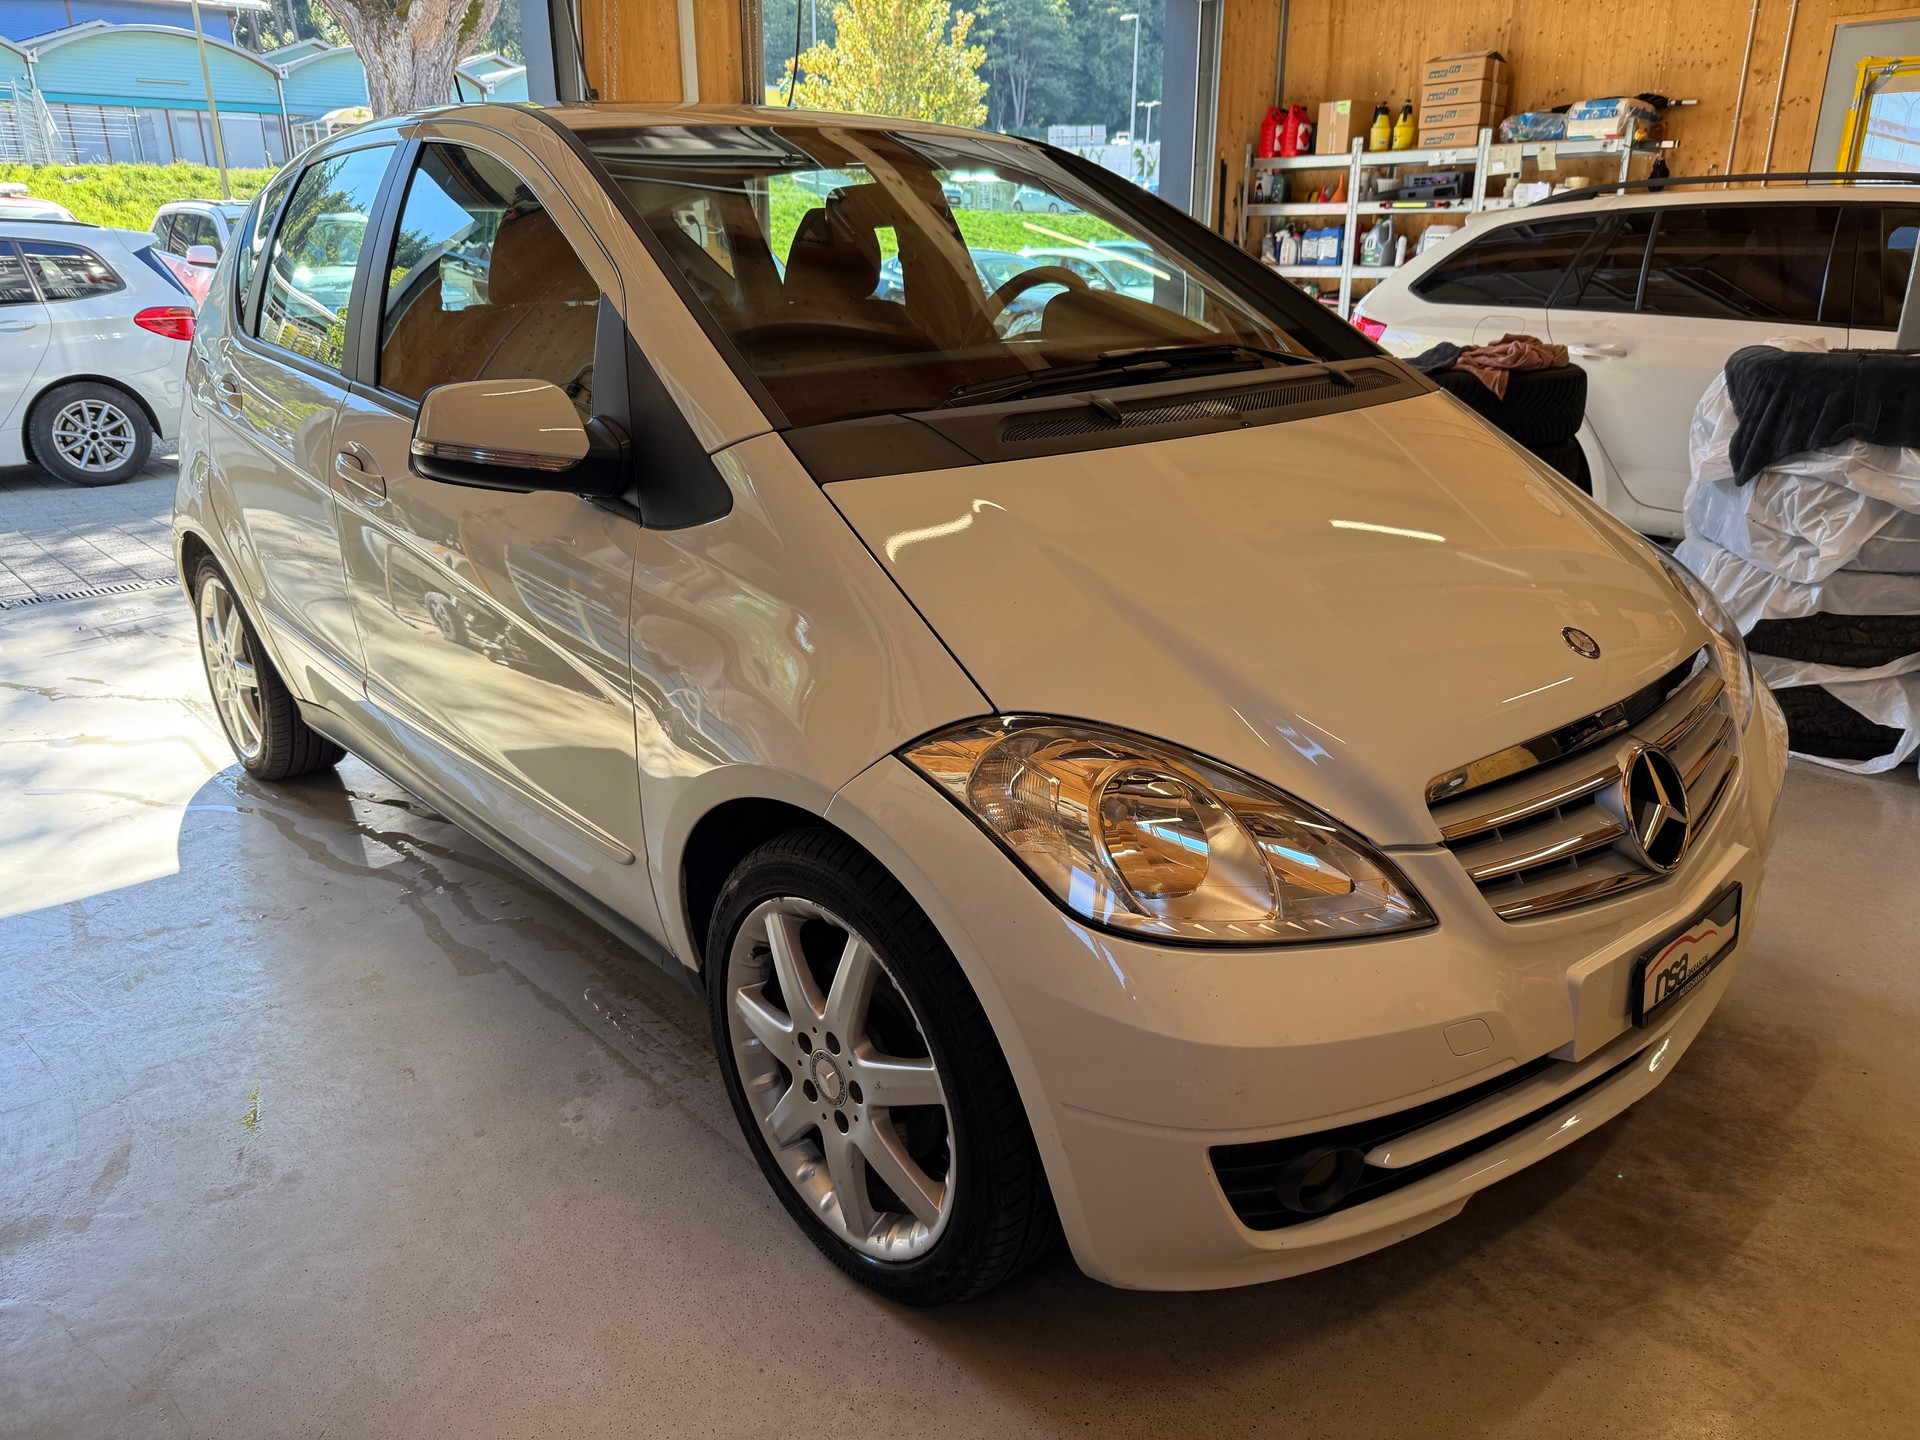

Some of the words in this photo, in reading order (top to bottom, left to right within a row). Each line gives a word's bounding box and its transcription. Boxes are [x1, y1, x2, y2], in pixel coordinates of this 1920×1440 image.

[861, 906, 892, 941] SPIRIT
[892, 944, 911, 969] PRO
[1654, 952, 1688, 1004] nsa
